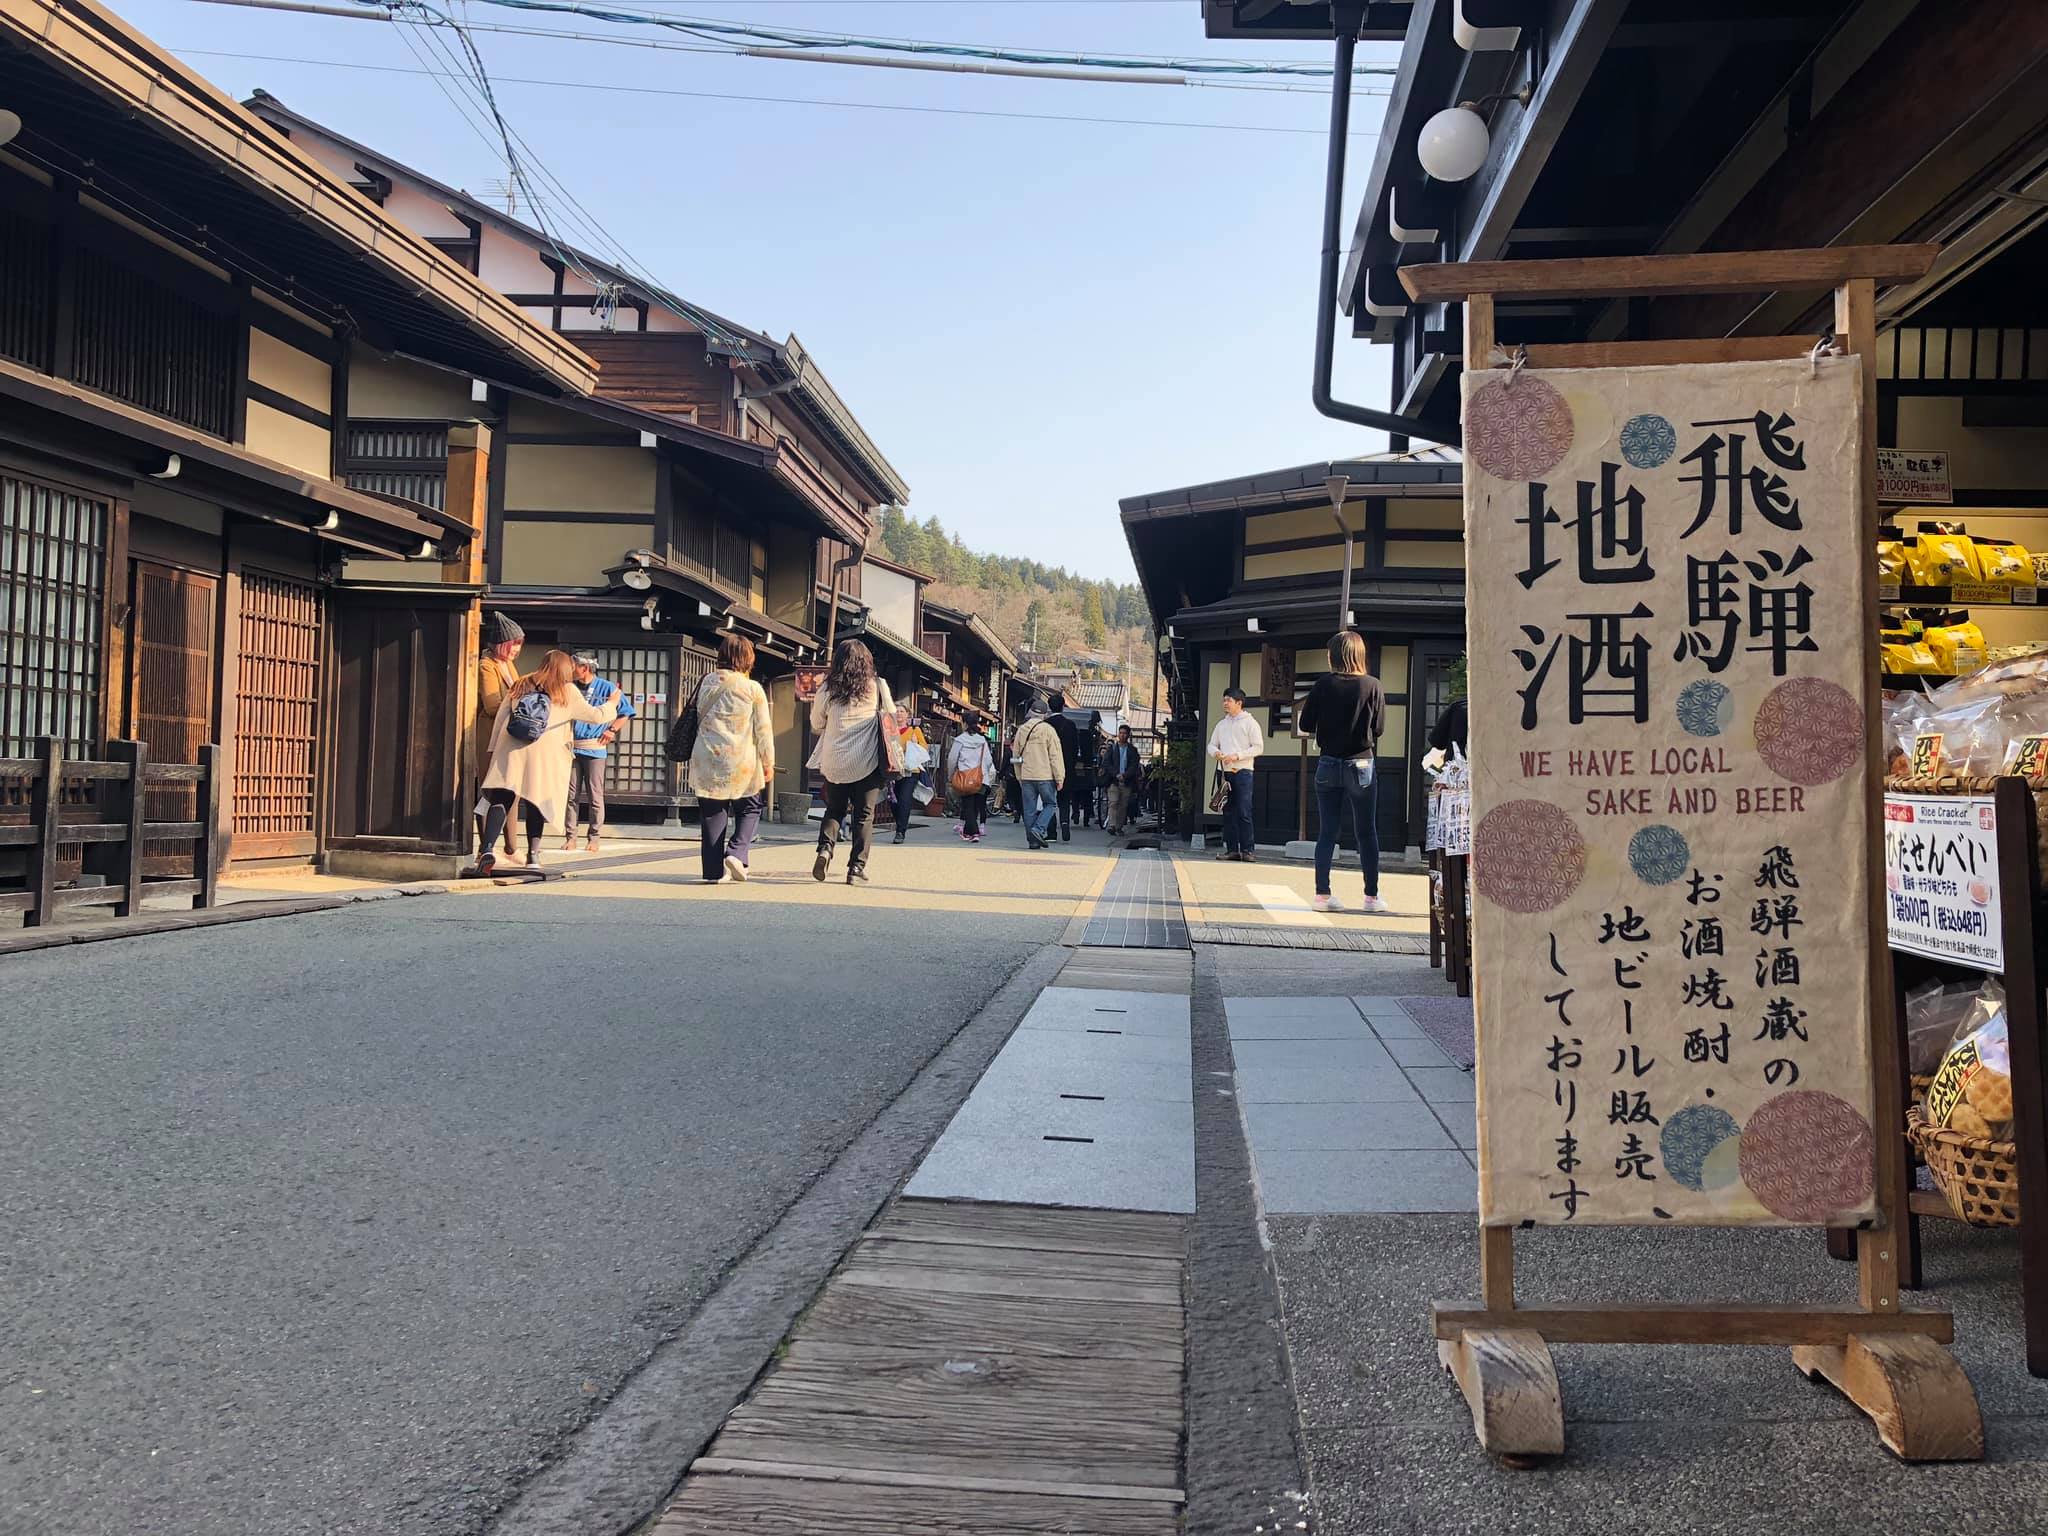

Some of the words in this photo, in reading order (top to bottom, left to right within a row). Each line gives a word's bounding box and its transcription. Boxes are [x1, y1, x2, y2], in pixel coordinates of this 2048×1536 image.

[1511, 461, 1656, 731] 地酒
[1674, 410, 1819, 676] 飛騨
[1520, 750, 1552, 777] WE
[1568, 749, 1635, 777] HAVE
[1650, 746, 1733, 776] LOCAL
[1586, 788, 1653, 816] SAKE
[1668, 787, 1717, 815] AND
[1735, 785, 1805, 815] BEER
[1921, 806, 1936, 817] Rice
[1938, 807, 1968, 818] Cracker
[1886, 831, 1988, 876] ひだせんべい
[1750, 845, 1809, 1086] 飛騨酒蔵の
[1544, 931, 1590, 1221] しております
